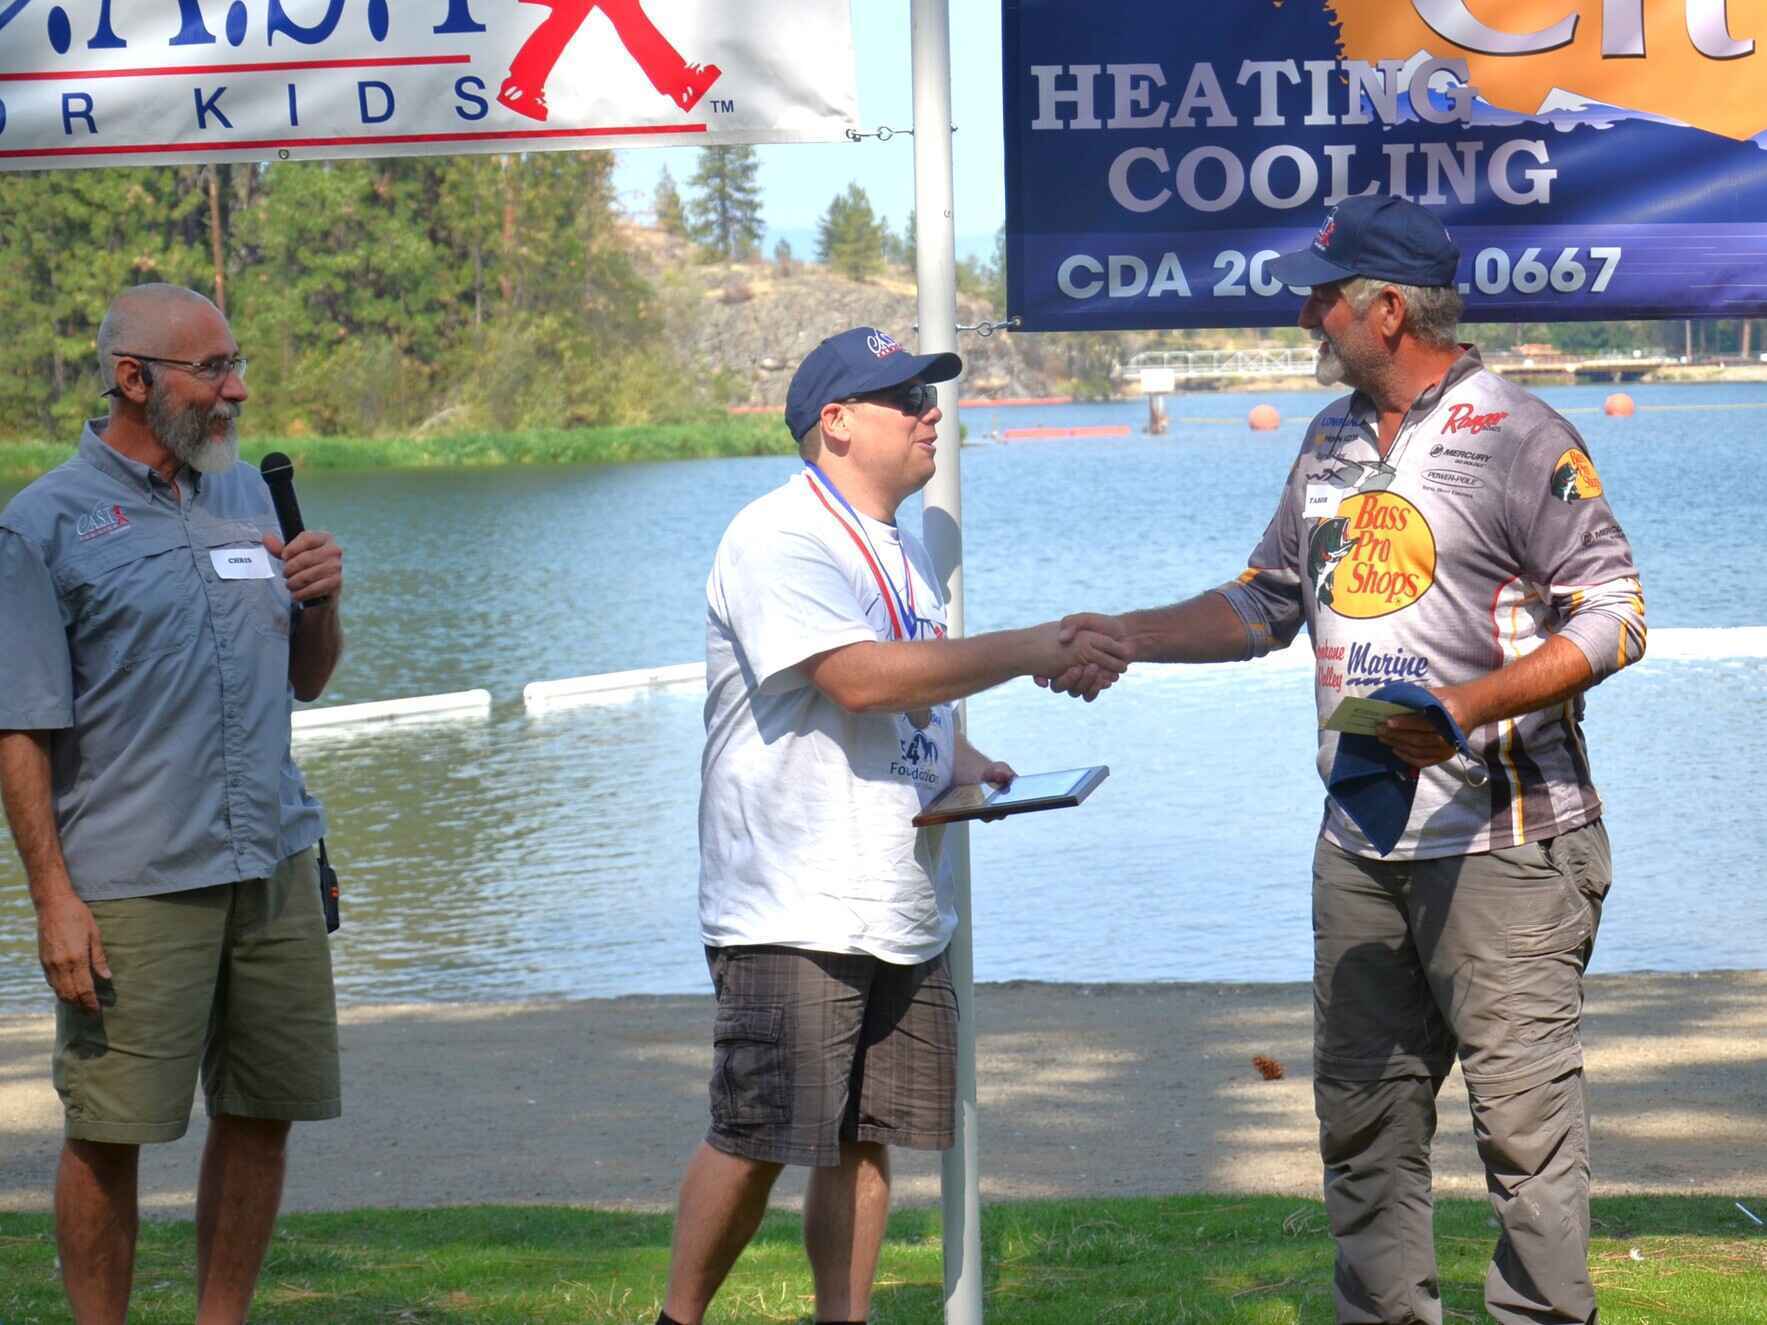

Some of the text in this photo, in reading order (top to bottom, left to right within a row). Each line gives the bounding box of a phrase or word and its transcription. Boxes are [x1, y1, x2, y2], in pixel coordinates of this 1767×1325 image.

[194, 77, 487, 130] KIDS
[1030, 58, 1478, 130] HEATING
[1108, 139, 1558, 213] COOLING
[1057, 252, 1192, 300] CDA
[1443, 448, 1493, 463] MERCURY
[1354, 494, 1411, 531] Bass
[1352, 530, 1391, 562] Pro
[1347, 562, 1420, 603] Shops
[1347, 642, 1429, 678] Marine
